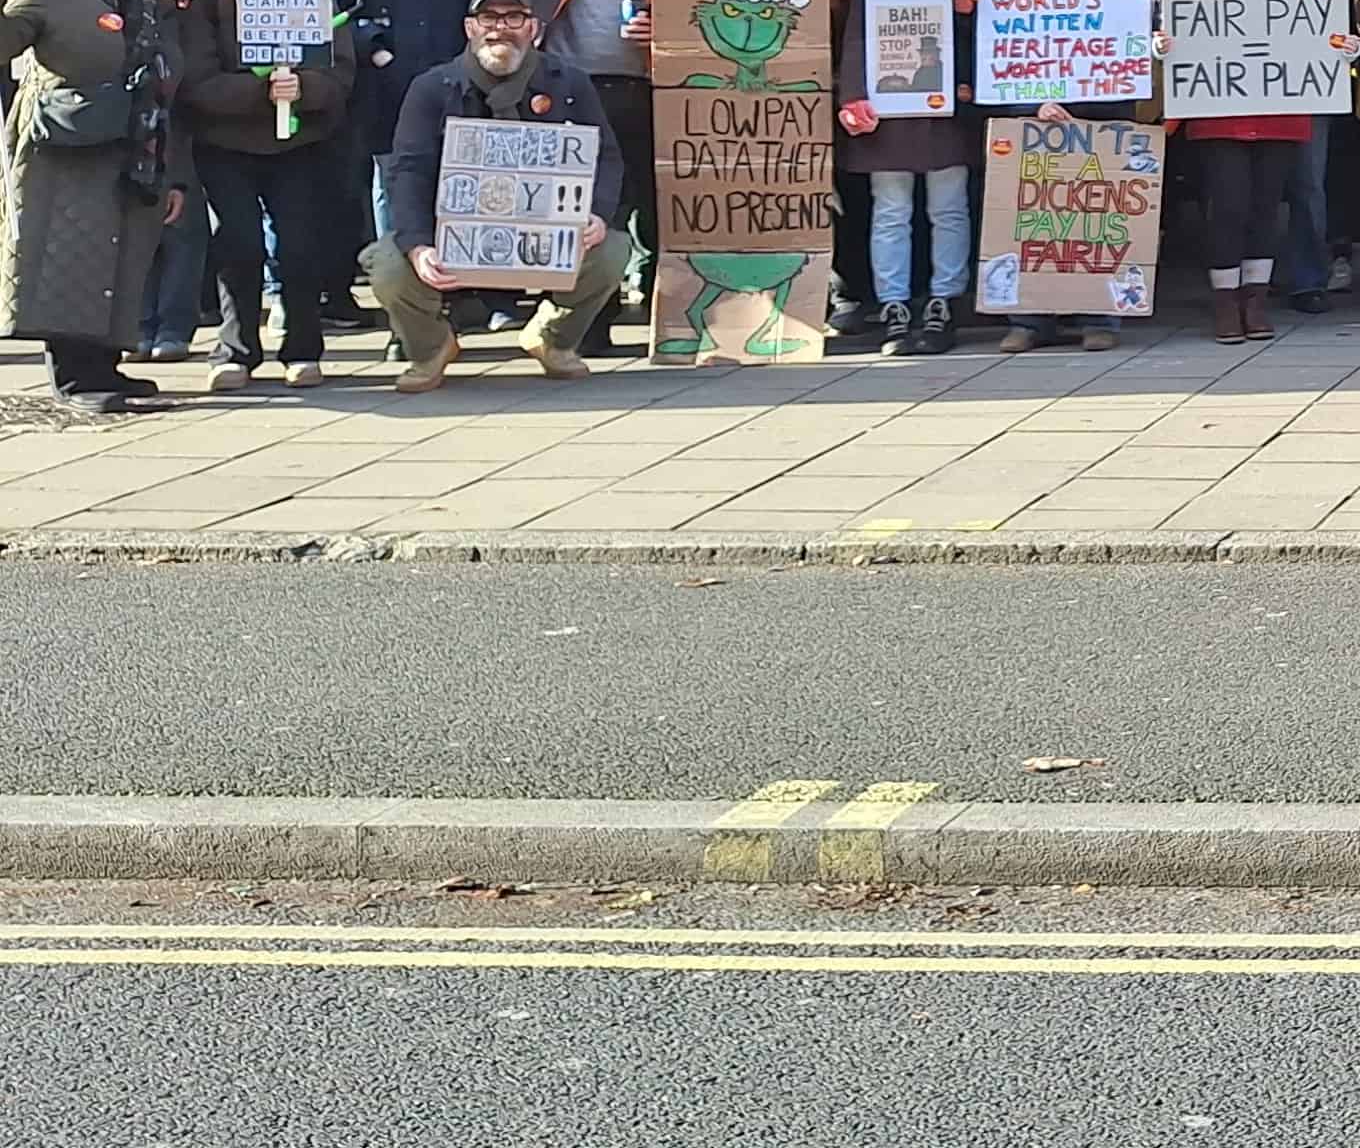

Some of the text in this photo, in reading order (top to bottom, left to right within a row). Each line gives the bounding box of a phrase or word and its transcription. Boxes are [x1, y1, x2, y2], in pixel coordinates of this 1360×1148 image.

[243, 12, 317, 24] GOT A
[888, 7, 928, 23] BAH!
[992, 12, 1105, 35] WRITTEN
[243, 29, 322, 42] BETTER
[878, 23, 941, 38] HUMBUG!
[244, 47, 302, 60] DEAL
[880, 39, 912, 52] STOP
[990, 57, 1151, 80] WORTH MORE
[1263, 60, 1341, 98] PLAY
[992, 77, 1137, 101] THAN THIS
[684, 96, 821, 138] LOW PAY
[1022, 122, 1134, 155] DON'T
[672, 140, 833, 185] DATA THEFT
[1021, 151, 1104, 180] BE A
[672, 192, 833, 235] NO PRESENTS
[1014, 210, 1129, 245] PAY US
[1019, 239, 1133, 274] FAIRLY
